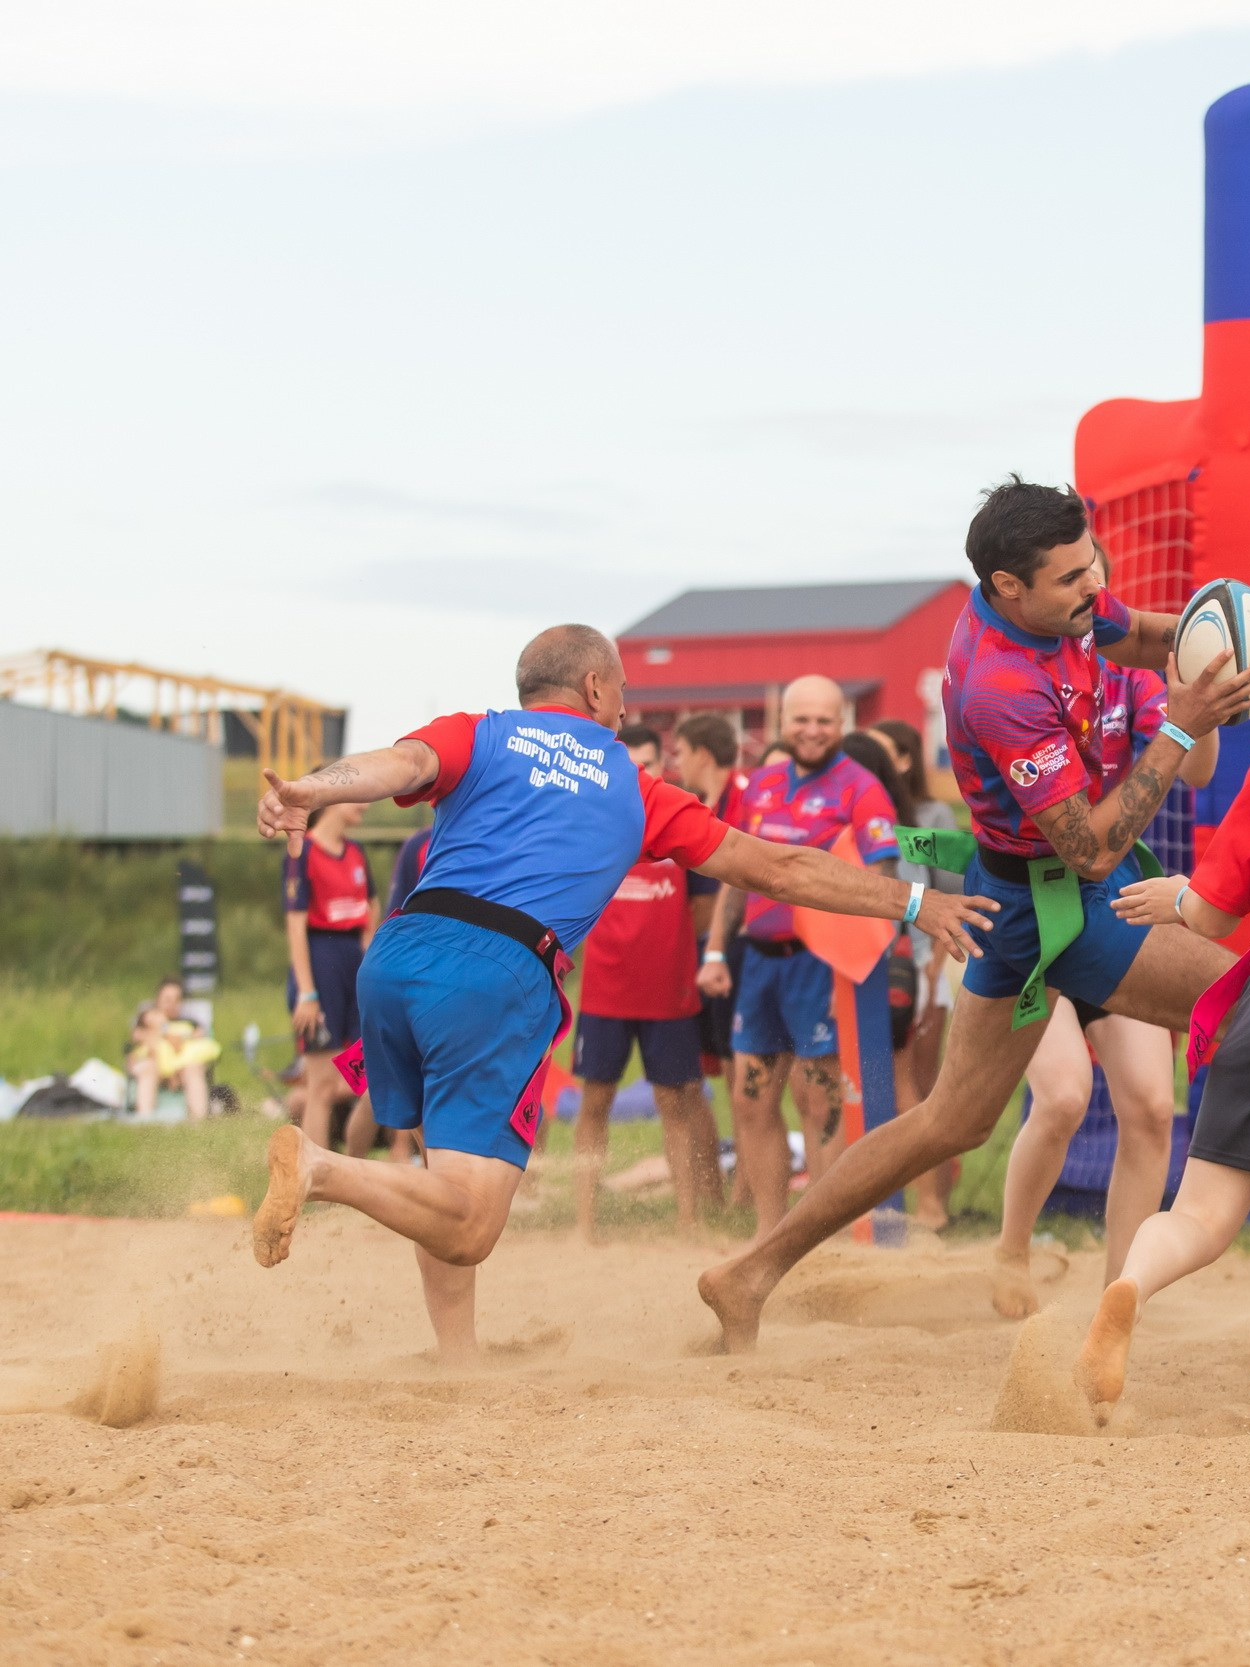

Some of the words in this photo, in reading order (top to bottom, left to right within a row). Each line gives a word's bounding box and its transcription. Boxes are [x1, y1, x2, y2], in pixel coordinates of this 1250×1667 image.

[506, 735, 551, 768] СПОРТА
[516, 725, 605, 766] МИНИСТЕРСТВО
[1031, 743, 1056, 760] ЦЕНТР
[1035, 744, 1068, 766] ИГРОВЫХ
[1039, 754, 1065, 771] ВИДОВ
[1043, 758, 1071, 776] СПОРТА
